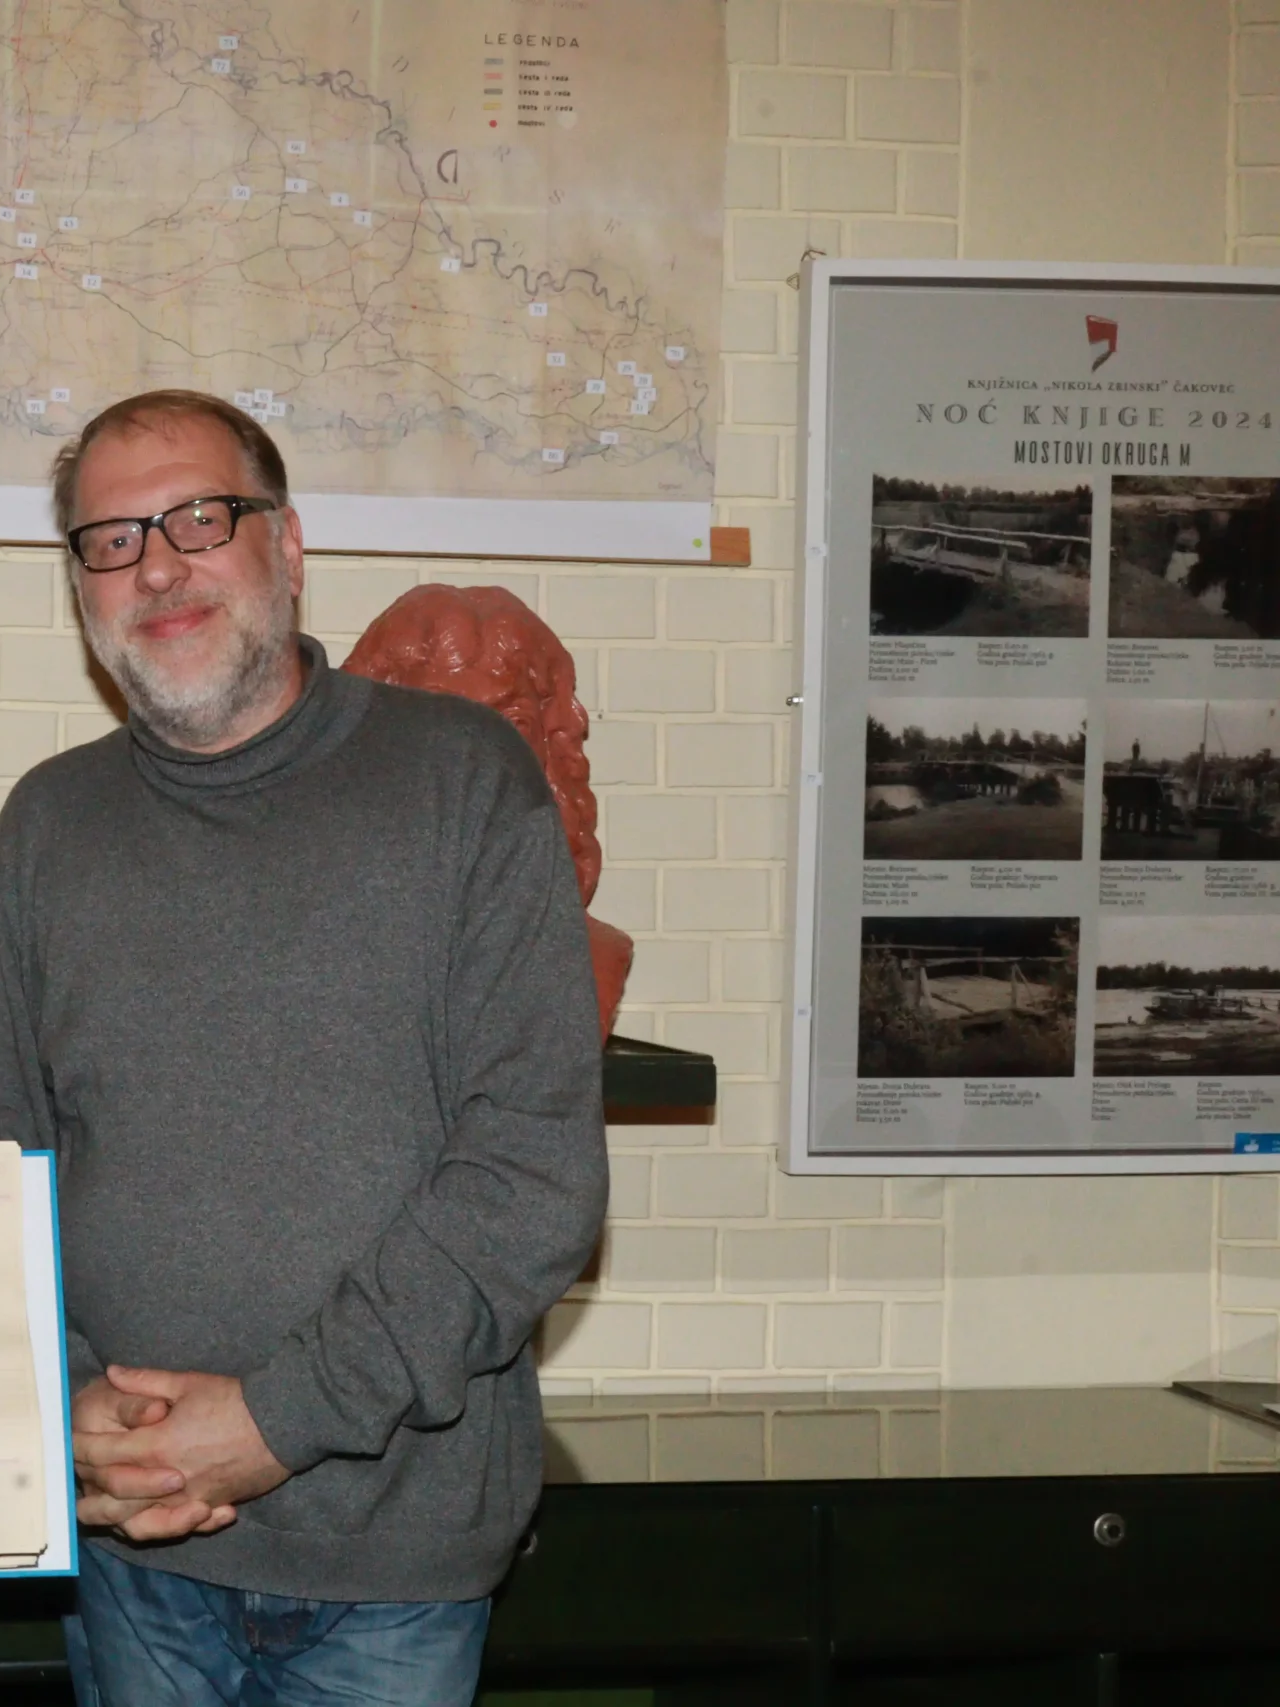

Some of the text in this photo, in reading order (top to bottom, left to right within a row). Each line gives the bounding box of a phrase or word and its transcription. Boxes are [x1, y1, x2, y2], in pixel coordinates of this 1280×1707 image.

[484, 33, 579, 48] LEGENDA
[967, 376, 1038, 391] KNJIŽNICA
[1173, 379, 1235, 394] ČAKOVEC
[915, 397, 999, 425] NOĆ
[1023, 404, 1165, 430] KNJIGE
[1014, 440, 1191, 467] MOSTOVI OKRUGA M
